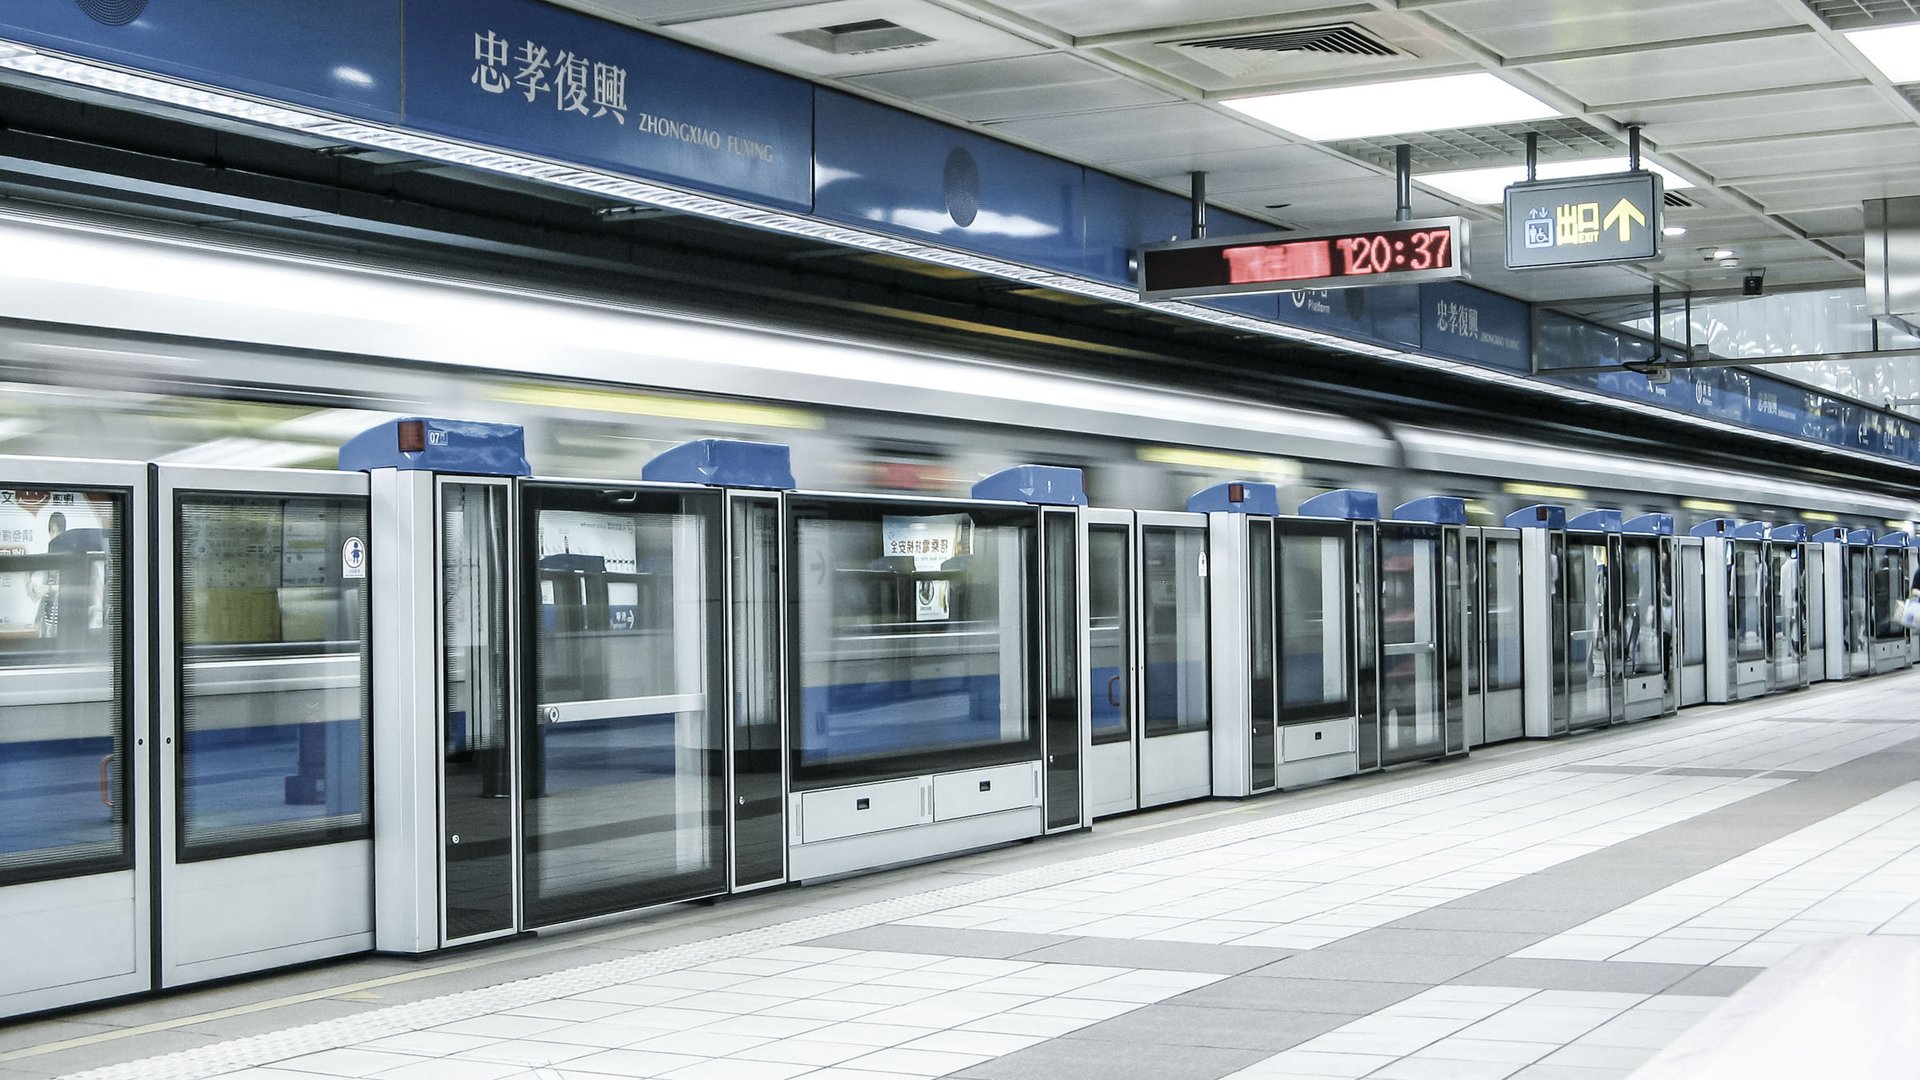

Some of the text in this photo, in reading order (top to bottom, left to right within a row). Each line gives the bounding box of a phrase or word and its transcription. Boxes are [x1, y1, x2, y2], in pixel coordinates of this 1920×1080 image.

[471, 29, 628, 126] 忠孝復興
[638, 112, 774, 163] ZHONGXIAO FUXING
[1556, 203, 1600, 247] 出口
[1578, 230, 1600, 243] EXIT
[1437, 299, 1479, 340] 忠孝復興
[430, 432, 440, 444] 07
